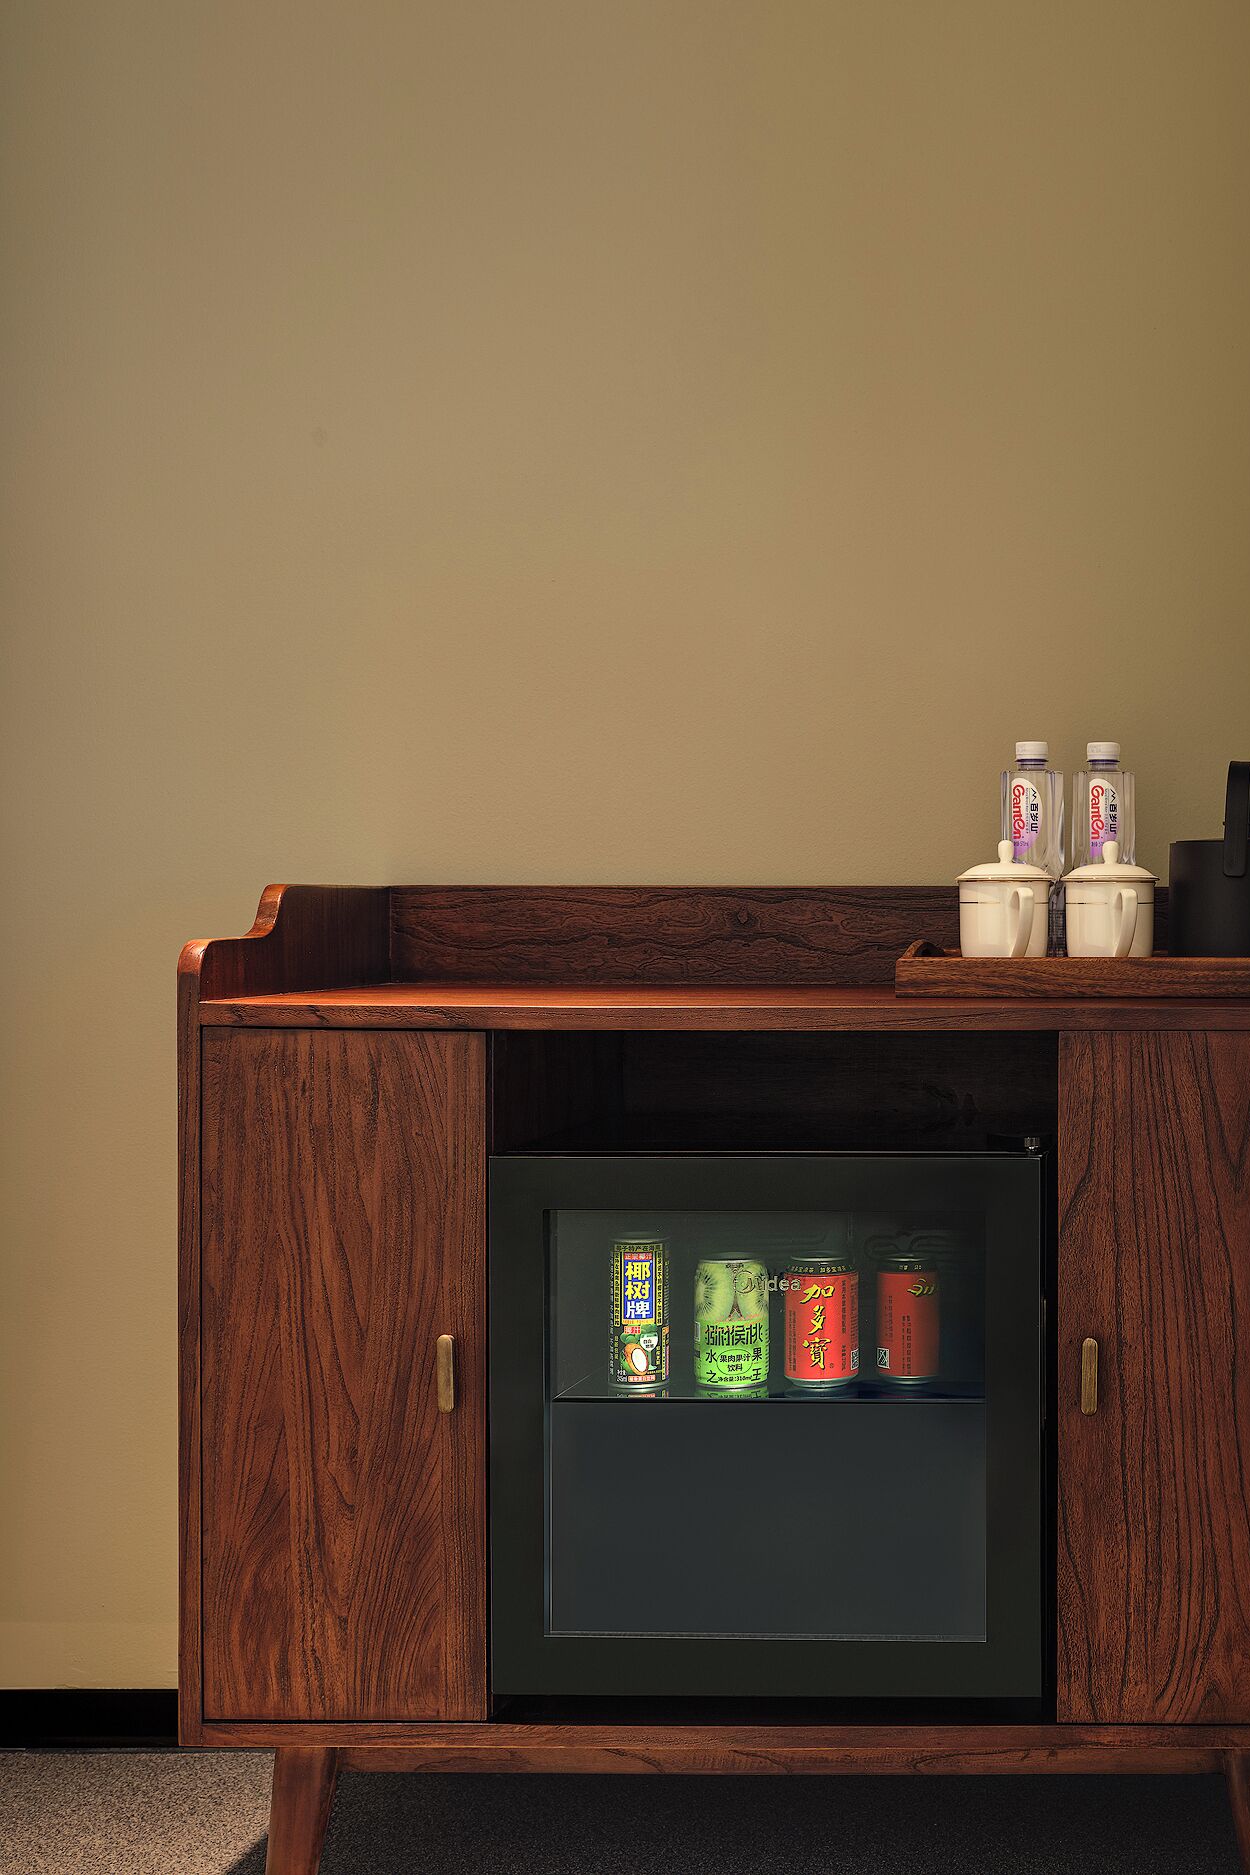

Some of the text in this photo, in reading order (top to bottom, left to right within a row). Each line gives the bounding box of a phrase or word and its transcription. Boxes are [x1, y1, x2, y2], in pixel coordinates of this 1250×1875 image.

[1030, 803, 1039, 832] 百岁山
[1109, 804, 1117, 833] 百岁山
[625, 1261, 651, 1319] 椰树牌
[705, 1349, 717, 1363] 水
[719, 1353, 751, 1362] 果肉果汁
[752, 1347, 762, 1361] 果
[727, 1363, 743, 1372] 饮料
[751, 1368, 761, 1381] 王
[706, 1370, 718, 1383] 之
